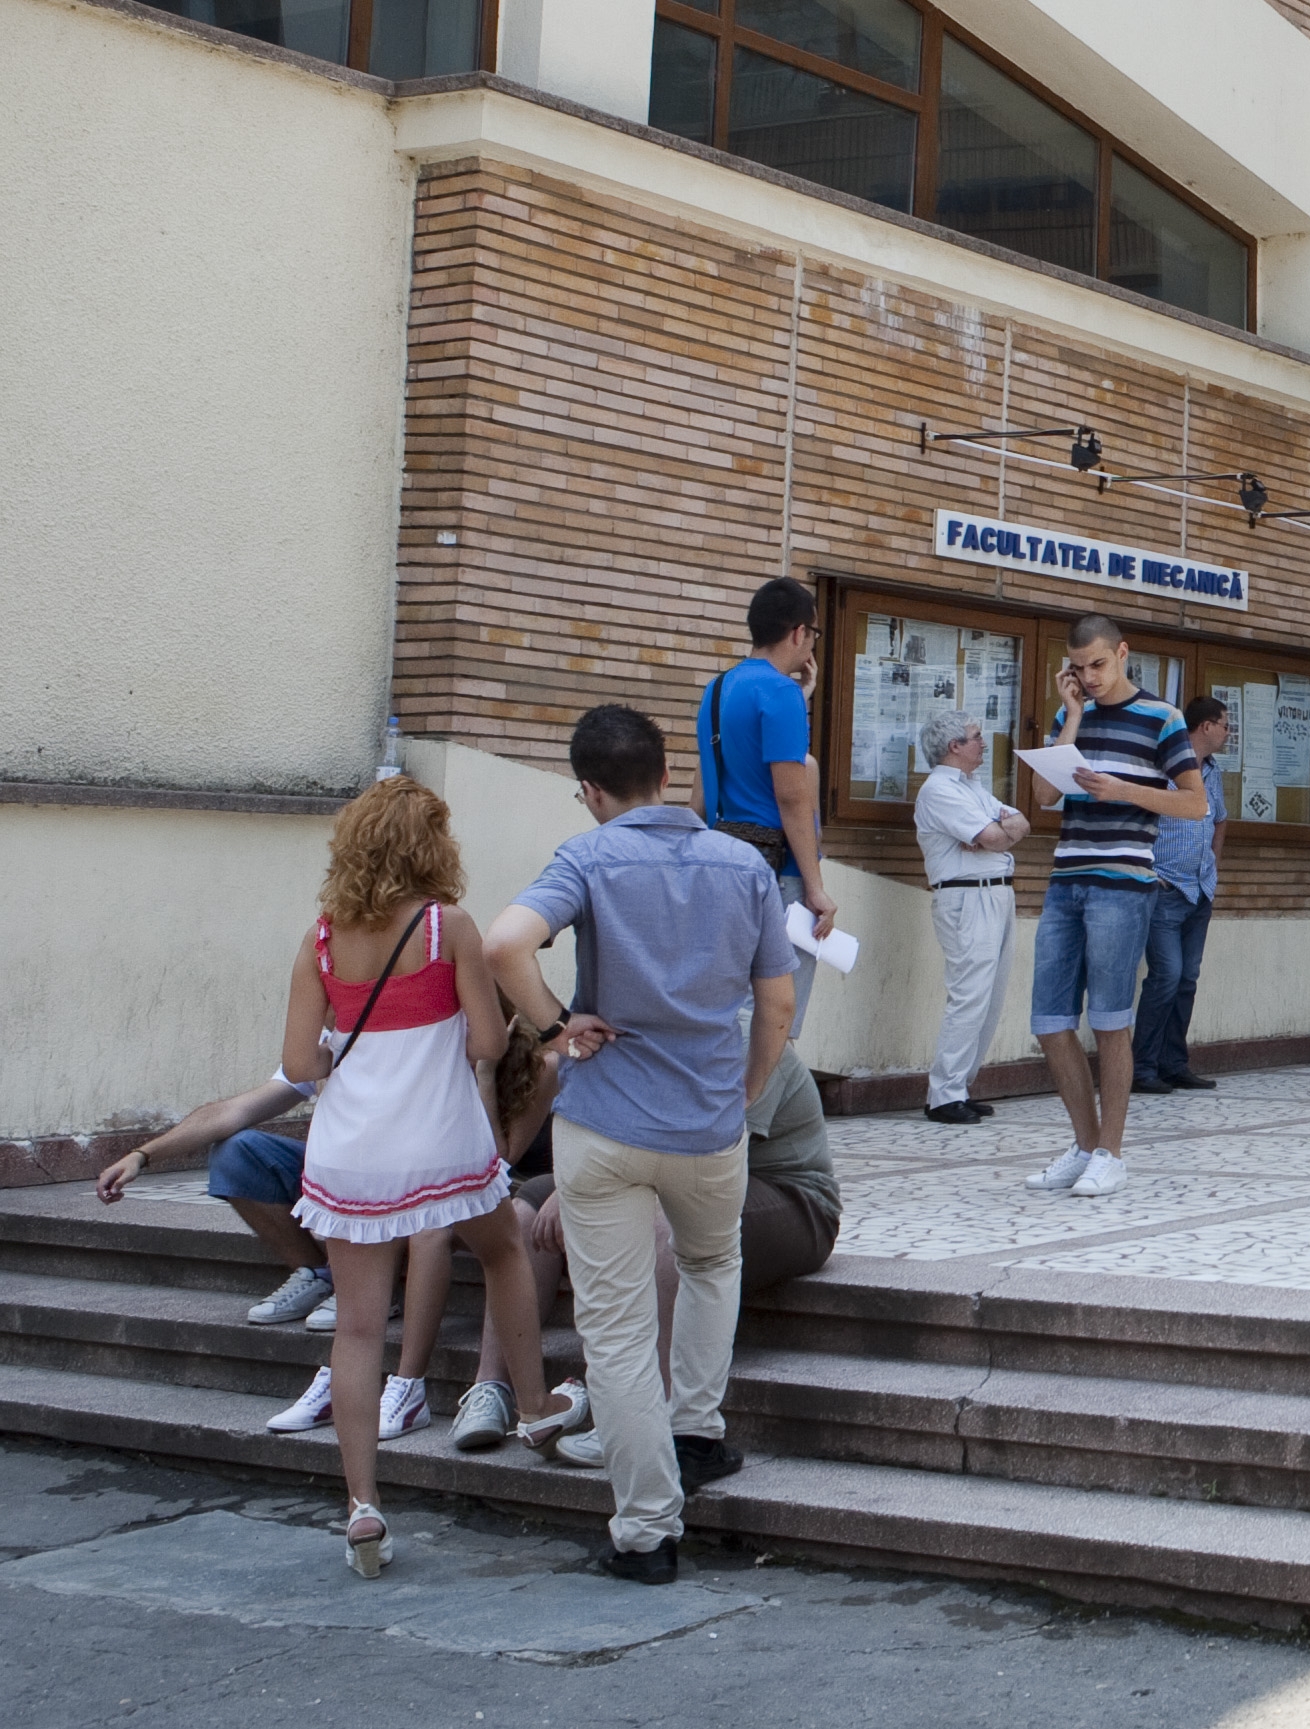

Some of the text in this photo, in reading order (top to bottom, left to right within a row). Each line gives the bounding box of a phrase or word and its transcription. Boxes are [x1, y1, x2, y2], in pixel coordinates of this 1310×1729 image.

[947, 520, 1243, 600] FACULTATEA DE MECANICĂ
